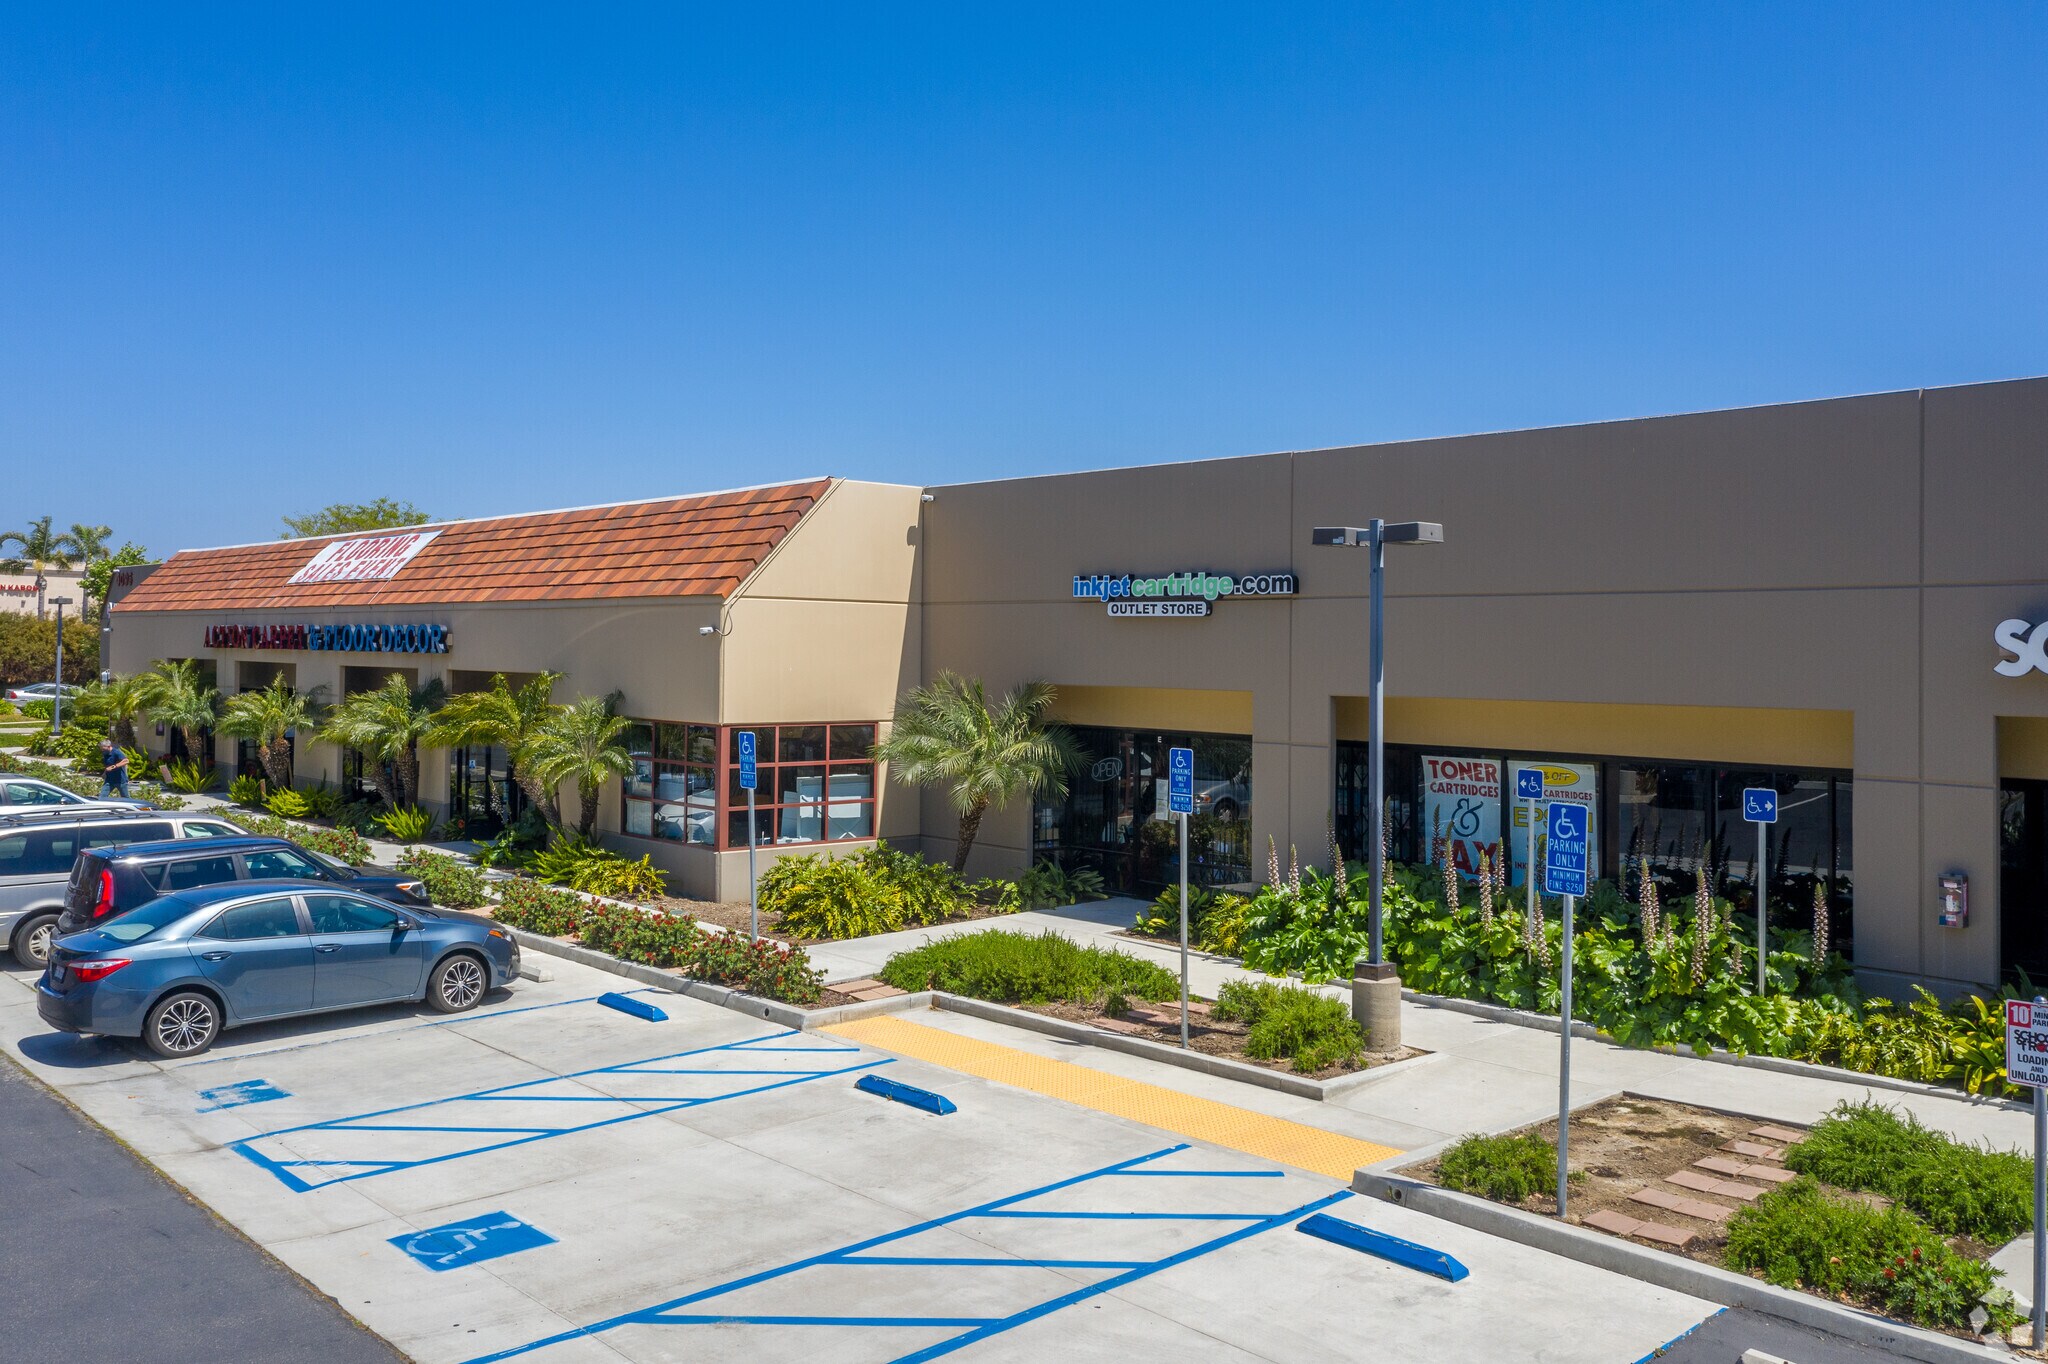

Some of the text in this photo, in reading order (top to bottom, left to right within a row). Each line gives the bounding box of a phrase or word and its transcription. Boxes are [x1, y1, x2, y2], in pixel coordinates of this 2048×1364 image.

[325, 535, 421, 562] FLOORING
[296, 558, 406, 582] SALES EVENT
[1073, 572, 1294, 602] inkjetcartridge.com
[1111, 603, 1203, 615] OUTLET STORE
[203, 624, 445, 654] ACTION CARPET & FLOOR DECOR
[1092, 762, 1121, 778] OPEN
[1171, 768, 1191, 776] PARKING
[1428, 760, 1499, 783] TONER
[1552, 772, 1571, 781] OFF
[1175, 775, 1187, 783] ONLY
[1430, 782, 1499, 798] CARTRIDGES
[1543, 789, 1593, 801] CARTRIDGES
[1451, 798, 1484, 837] &
[1549, 838, 1585, 855] PARKING
[1555, 853, 1577, 868] ONLY
[1552, 870, 1580, 882] MINIMUM
[1549, 880, 1563, 890] FINE
[1565, 882, 1583, 893] $250
[2010, 1005, 2029, 1025] 10
